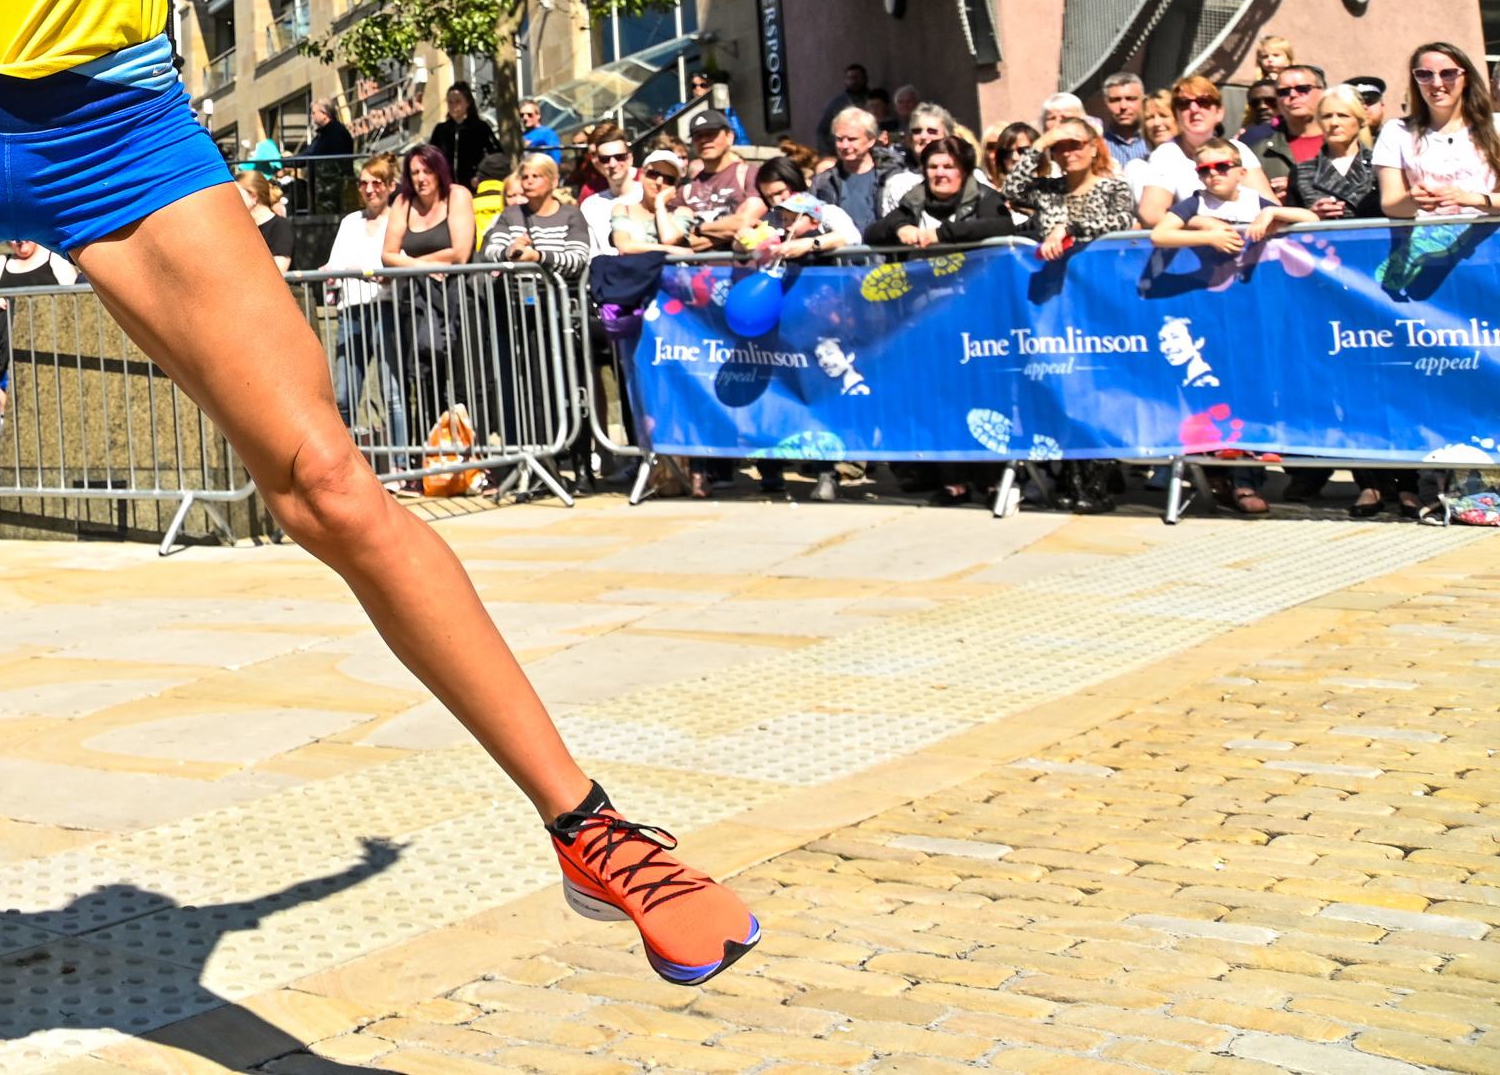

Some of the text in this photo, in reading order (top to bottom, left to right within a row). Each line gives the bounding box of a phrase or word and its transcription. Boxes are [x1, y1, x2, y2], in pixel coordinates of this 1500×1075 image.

[651, 336, 810, 369] Jane Tomlinson
[959, 326, 1149, 365] Jane Tomlinson
[1328, 320, 1394, 356] Jane
[1023, 356, 1075, 381] appeal
[1414, 349, 1481, 376] appeal
